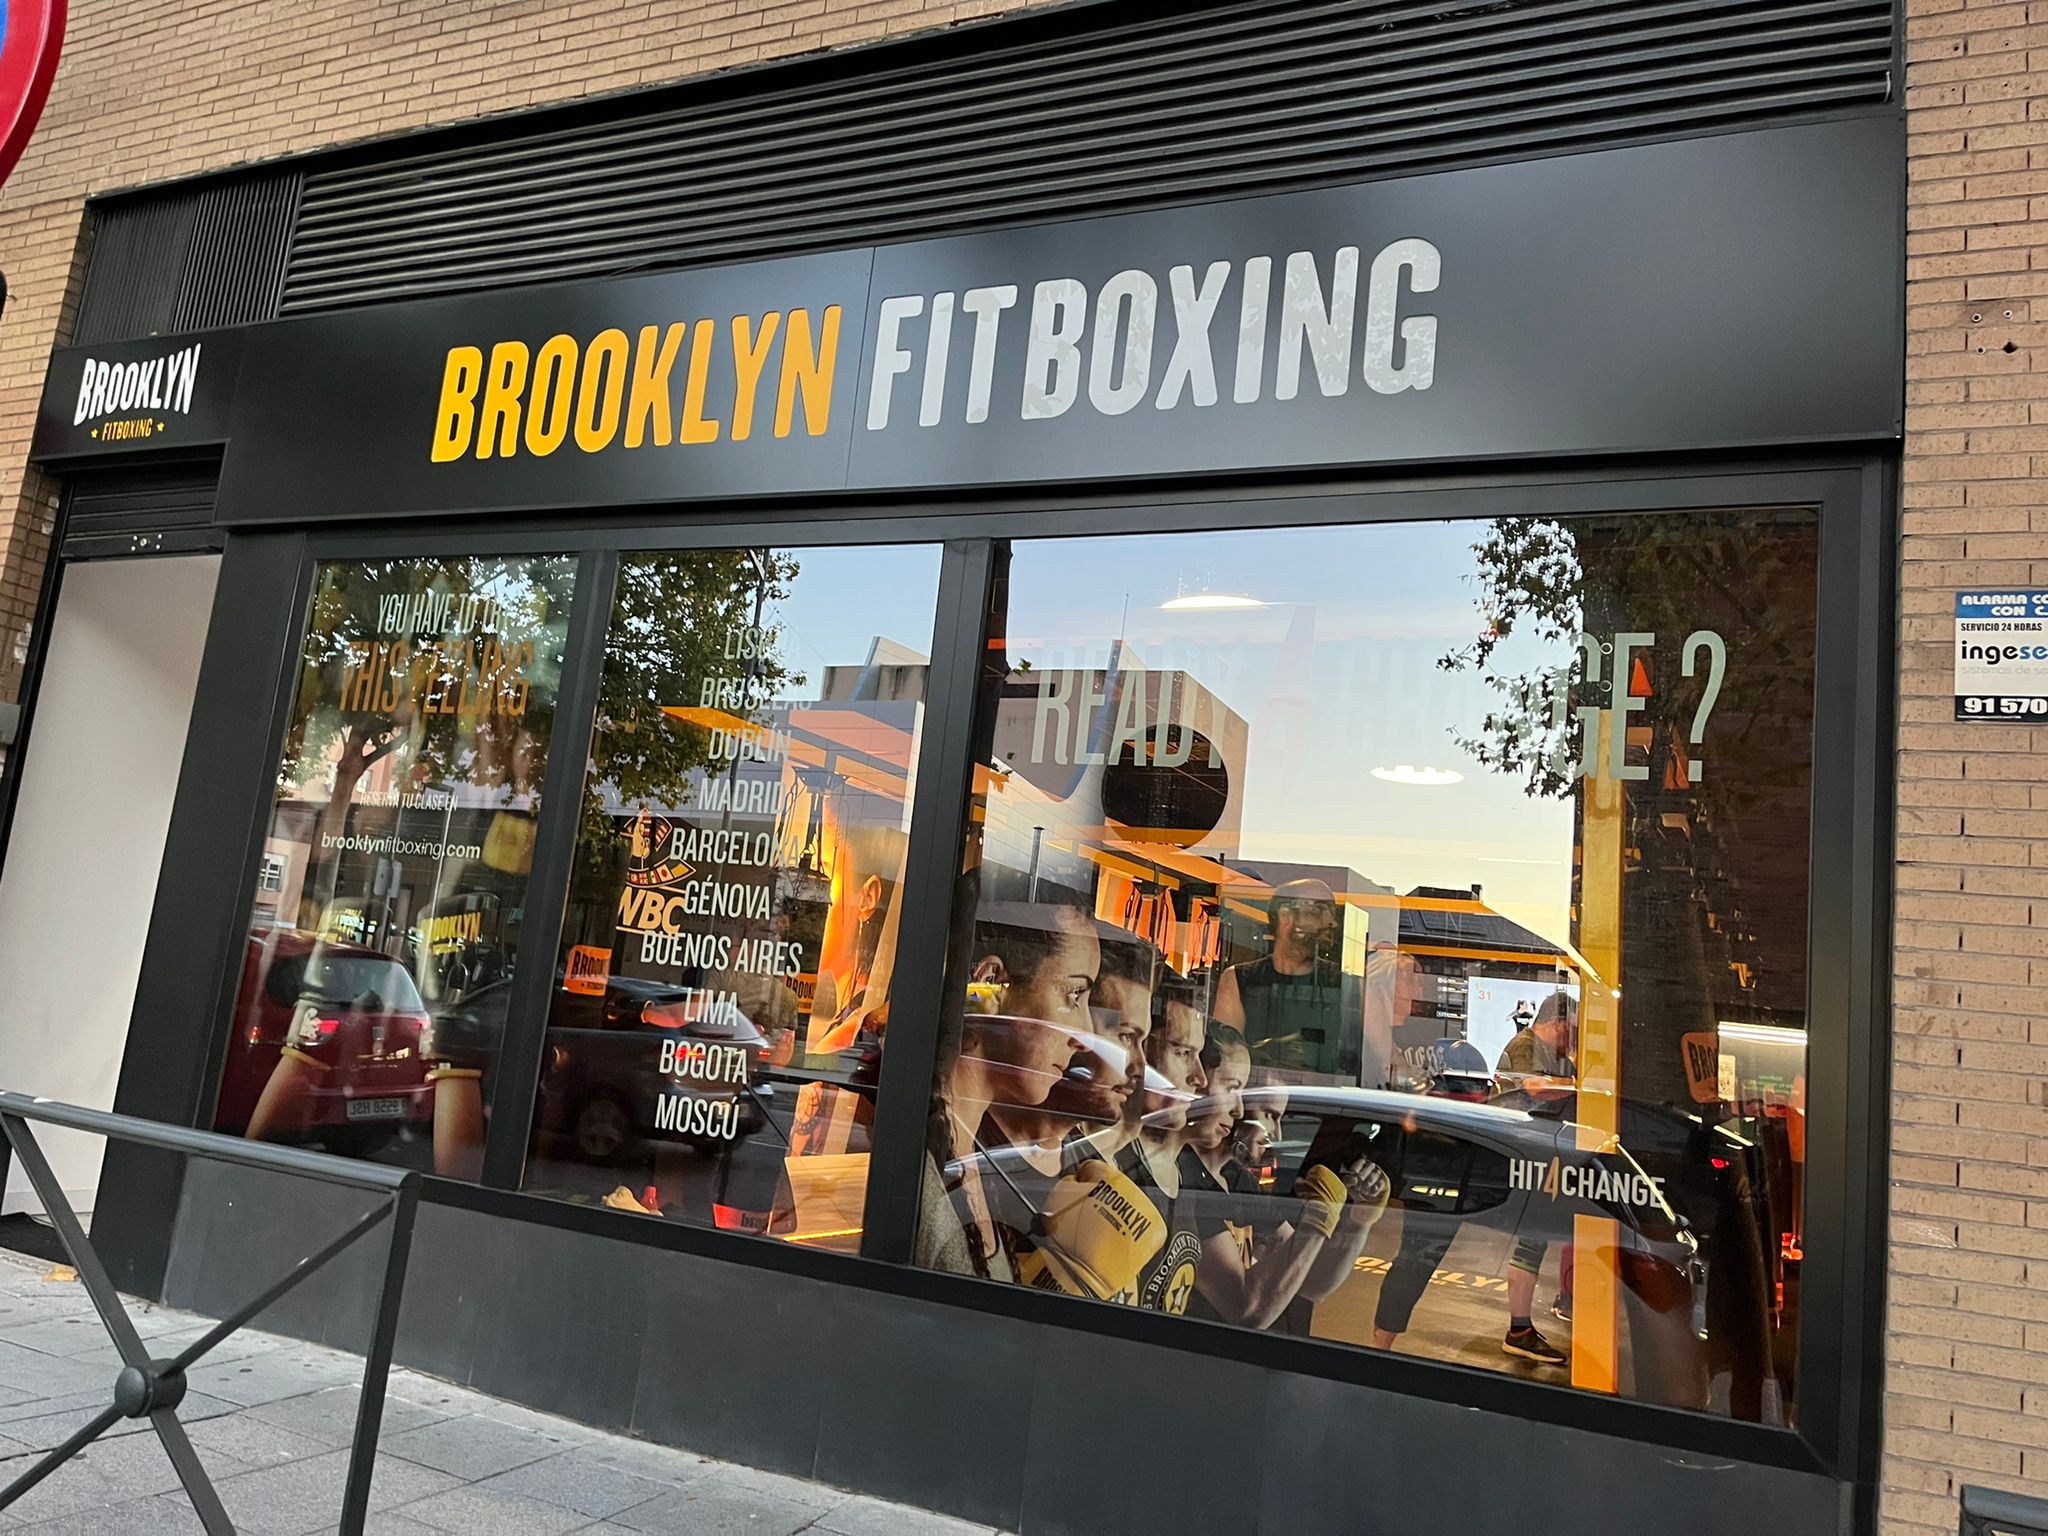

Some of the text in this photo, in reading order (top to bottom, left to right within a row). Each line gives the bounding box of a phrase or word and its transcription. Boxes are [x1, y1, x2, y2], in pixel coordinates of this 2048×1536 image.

[74, 343, 201, 426] BROOKLYN
[430, 304, 842, 463] BROOKLYN
[102, 418, 153, 441] FITBOXING
[377, 594, 411, 634] YOU
[410, 593, 455, 635] HAVE
[1962, 594, 2028, 606] ALARMA
[1991, 606, 2025, 616] CON
[1961, 622, 2042, 632] SERVICIO 24 HORAS
[339, 640, 409, 713] THIS
[1681, 630, 1727, 783] ?
[1964, 697, 2048, 714] 91 570
[708, 723, 792, 762] DUBLÍN
[415, 794, 444, 811] CLASE
[698, 778, 786, 815] MADRID
[321, 832, 481, 860] brooklynfitboxing.com
[669, 828, 800, 868] BARCELONA
[684, 874, 771, 920] GÉNOVA
[641, 930, 803, 978] BUENOS AIRES
[684, 987, 738, 1026] LIMA
[659, 1038, 748, 1084] BOGOTA
[655, 1093, 740, 1140] MOSCÚ
[1509, 1156, 1666, 1209] HIT4CHANGE
[1088, 1180, 1152, 1242] BROOKLYN
